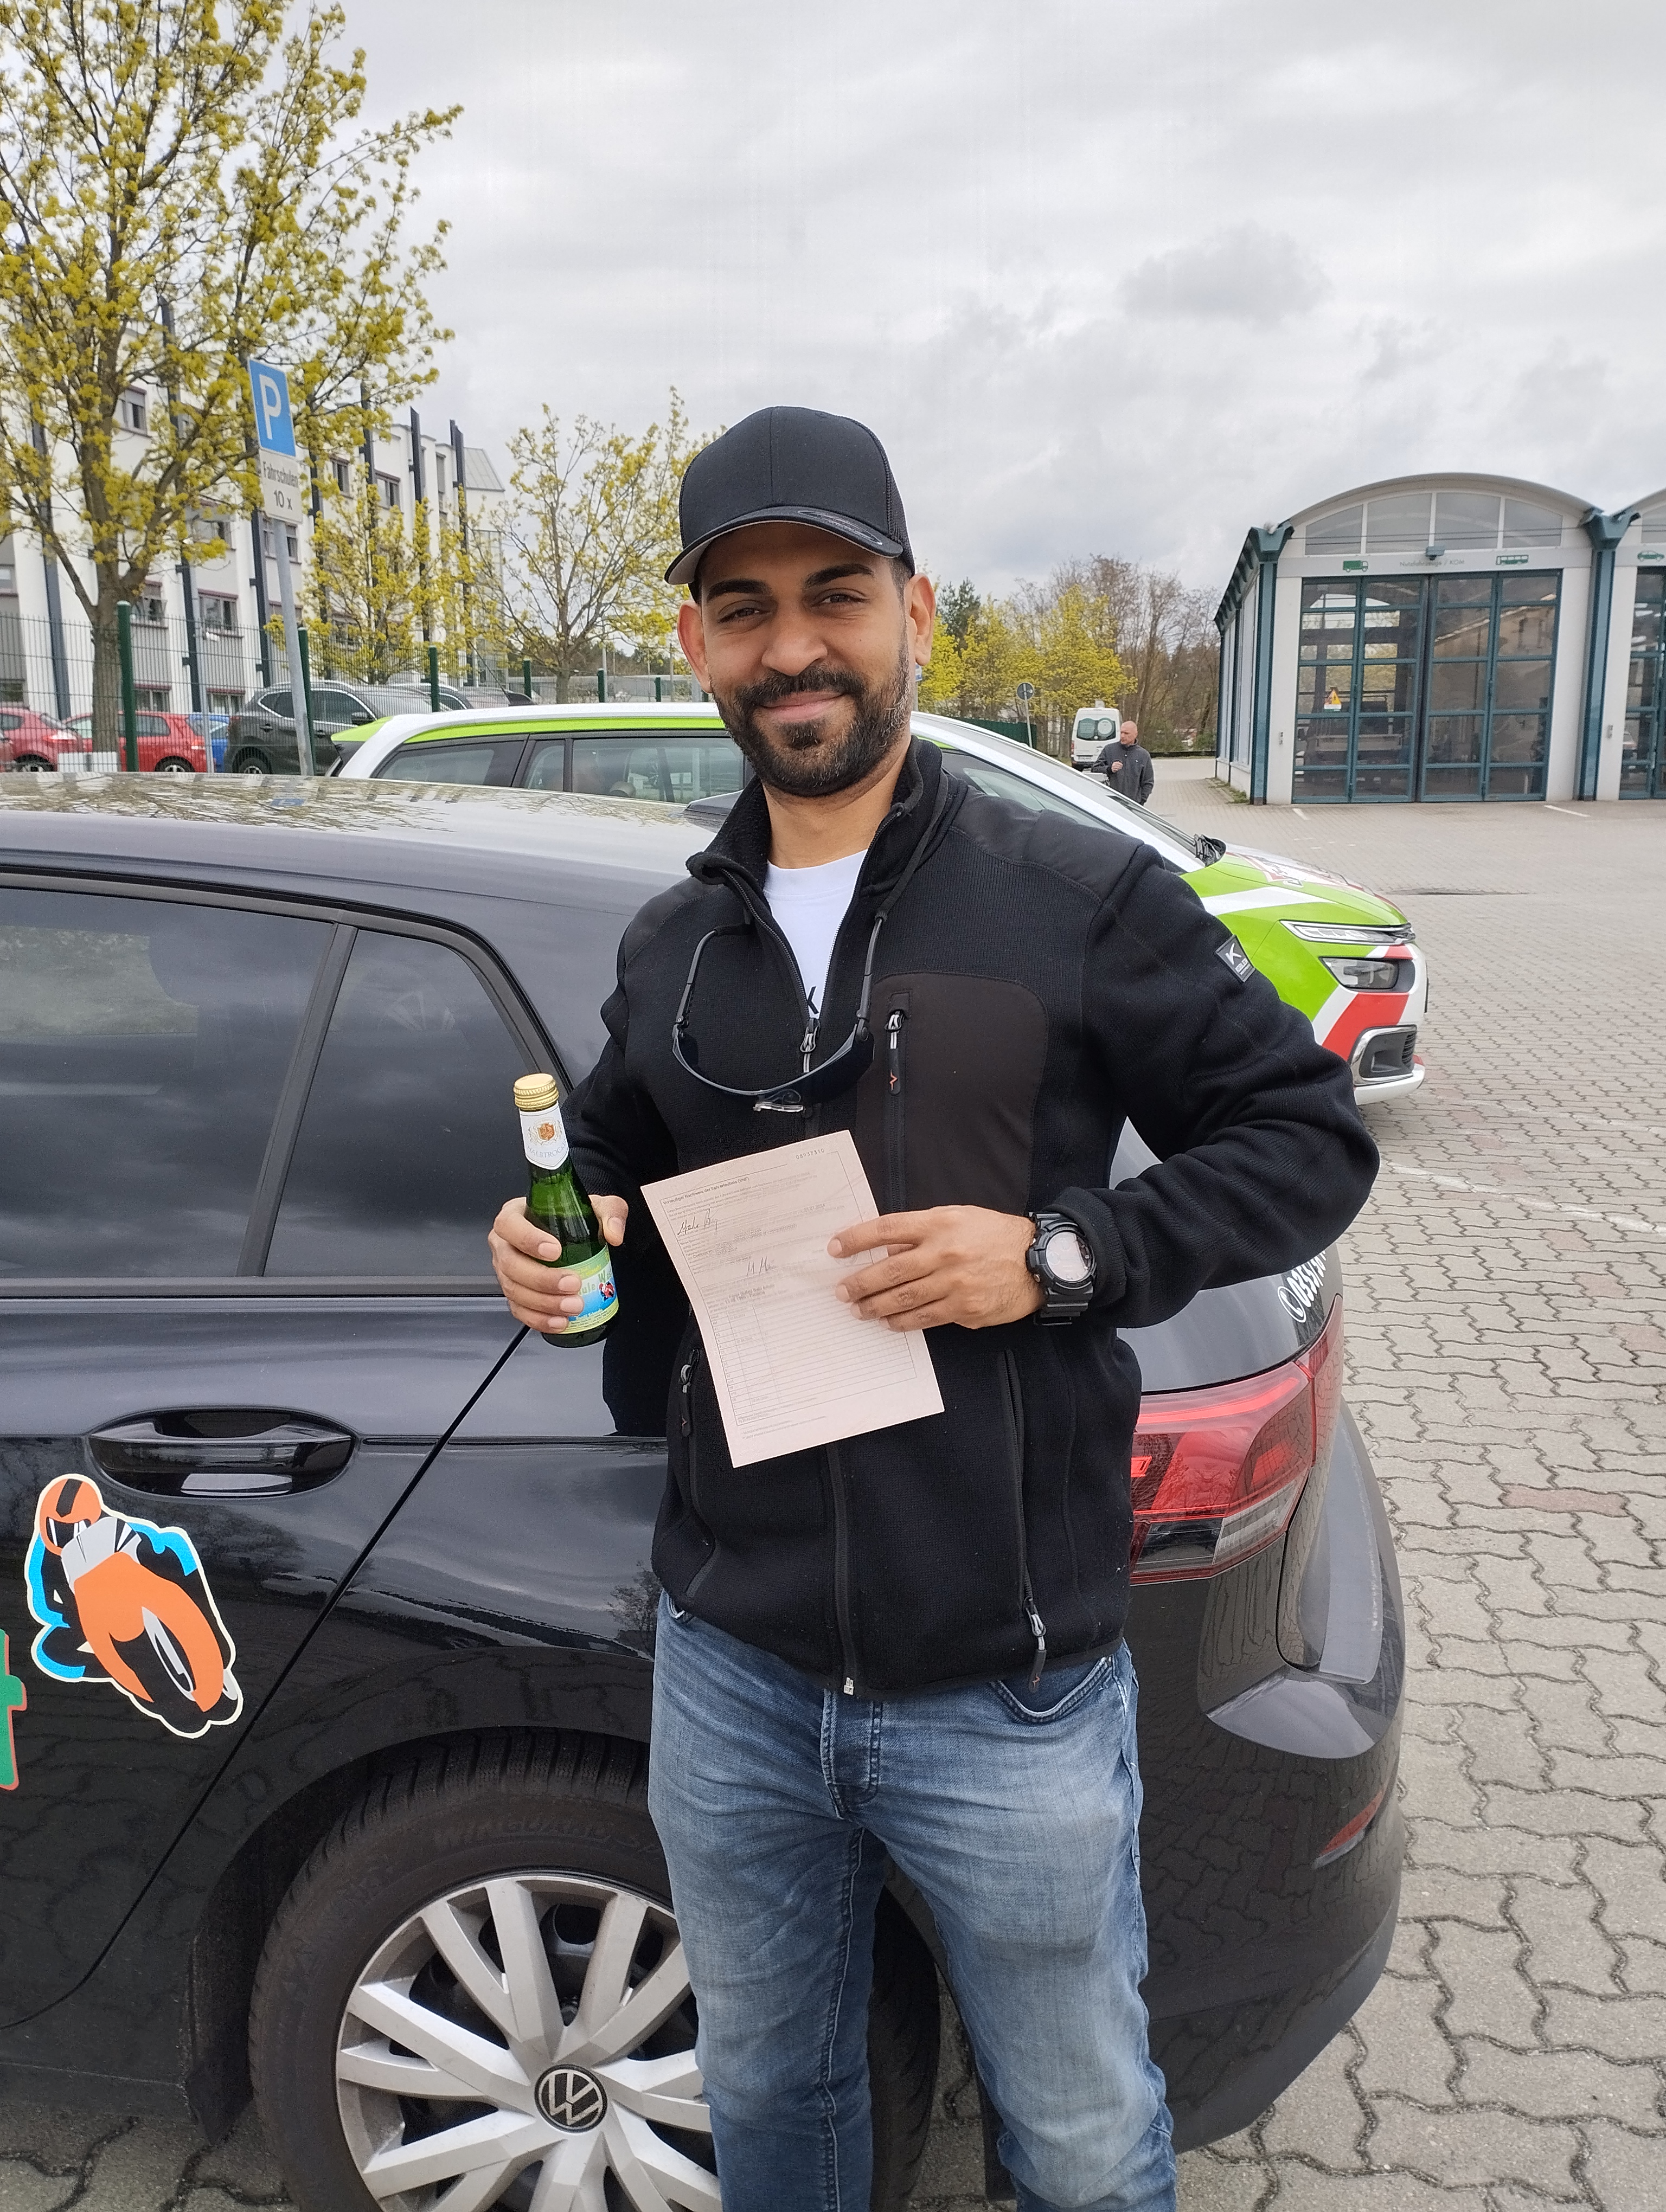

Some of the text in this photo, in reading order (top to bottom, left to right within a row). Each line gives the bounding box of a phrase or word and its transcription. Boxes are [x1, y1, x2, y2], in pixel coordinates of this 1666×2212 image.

[259, 374, 281, 440] P
[263, 461, 299, 488] Fahrschulen
[274, 490, 285, 508] 10
[527, 1139, 567, 1158] HALBTROCKE
